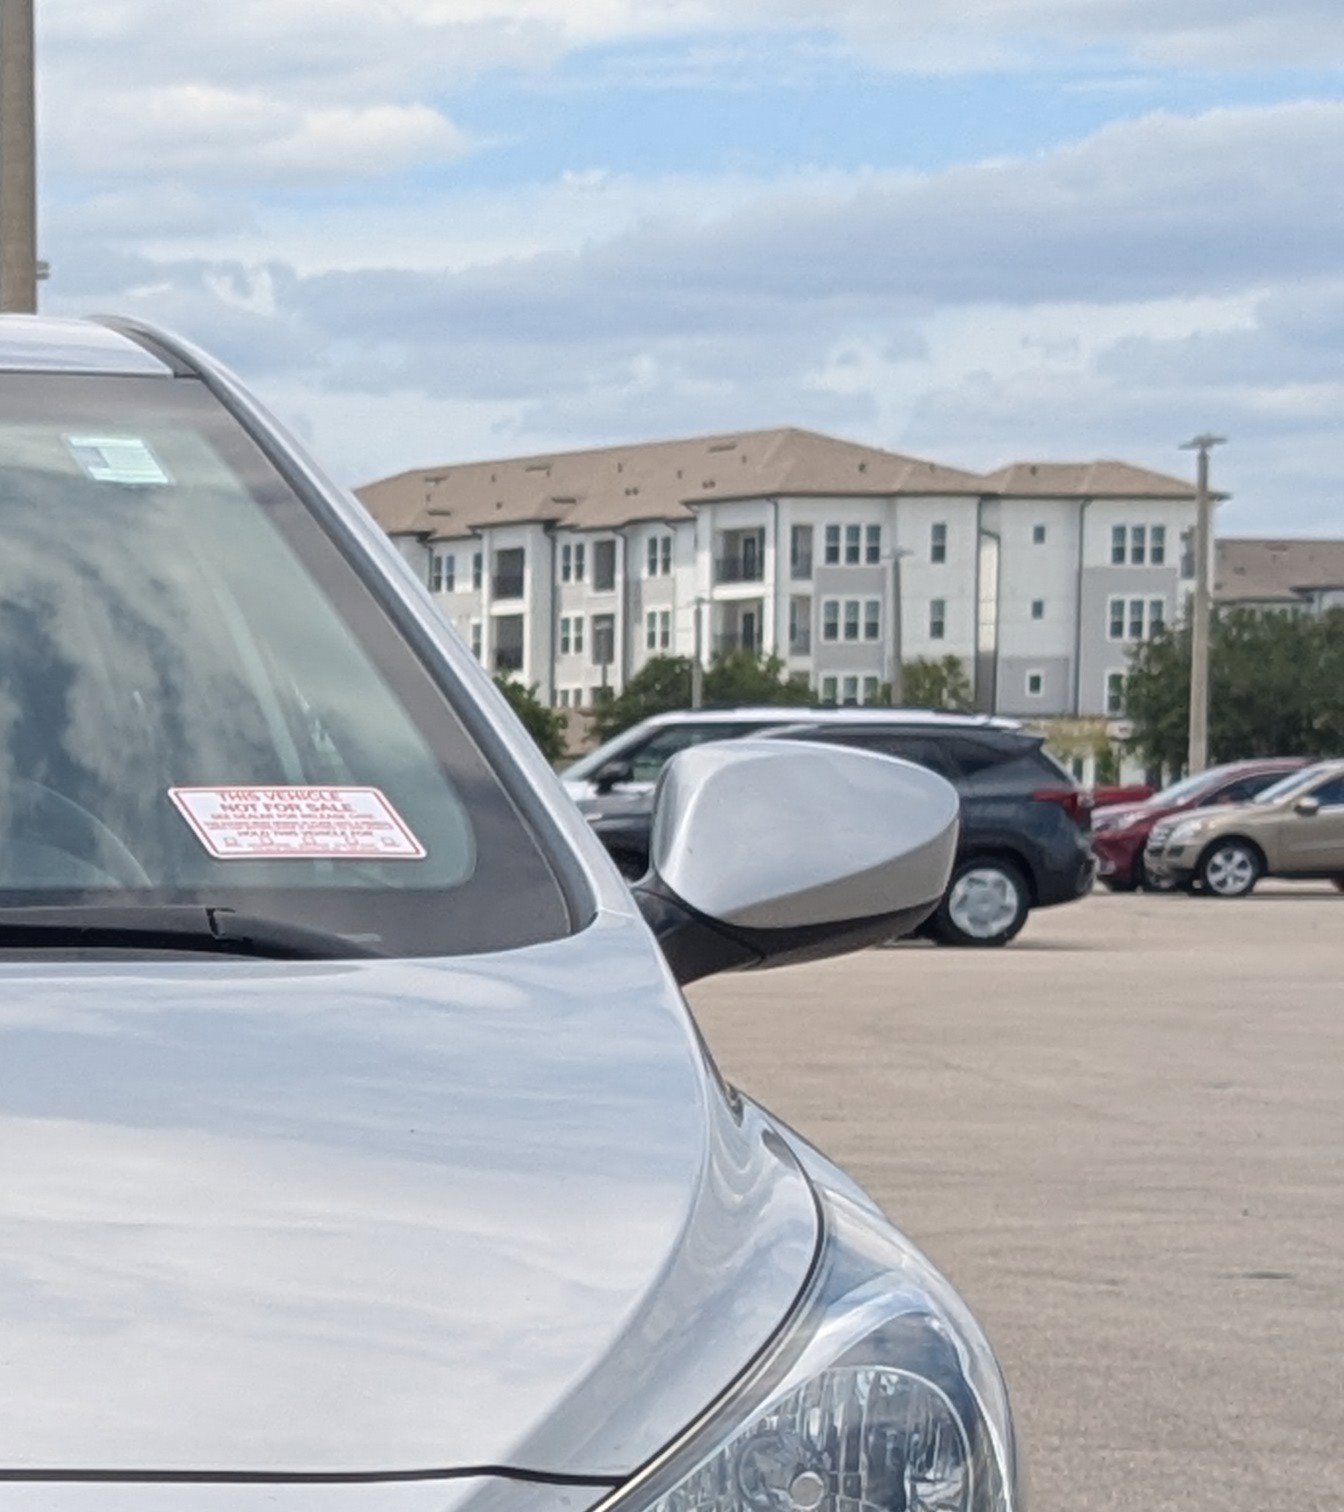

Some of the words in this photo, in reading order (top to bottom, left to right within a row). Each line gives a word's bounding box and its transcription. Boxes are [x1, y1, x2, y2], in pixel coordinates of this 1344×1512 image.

[217, 790, 261, 802] THIS
[264, 790, 343, 802] VEHICLE
[220, 803, 258, 812] NOT
[263, 803, 302, 812] FOR
[305, 803, 354, 812] SALE
